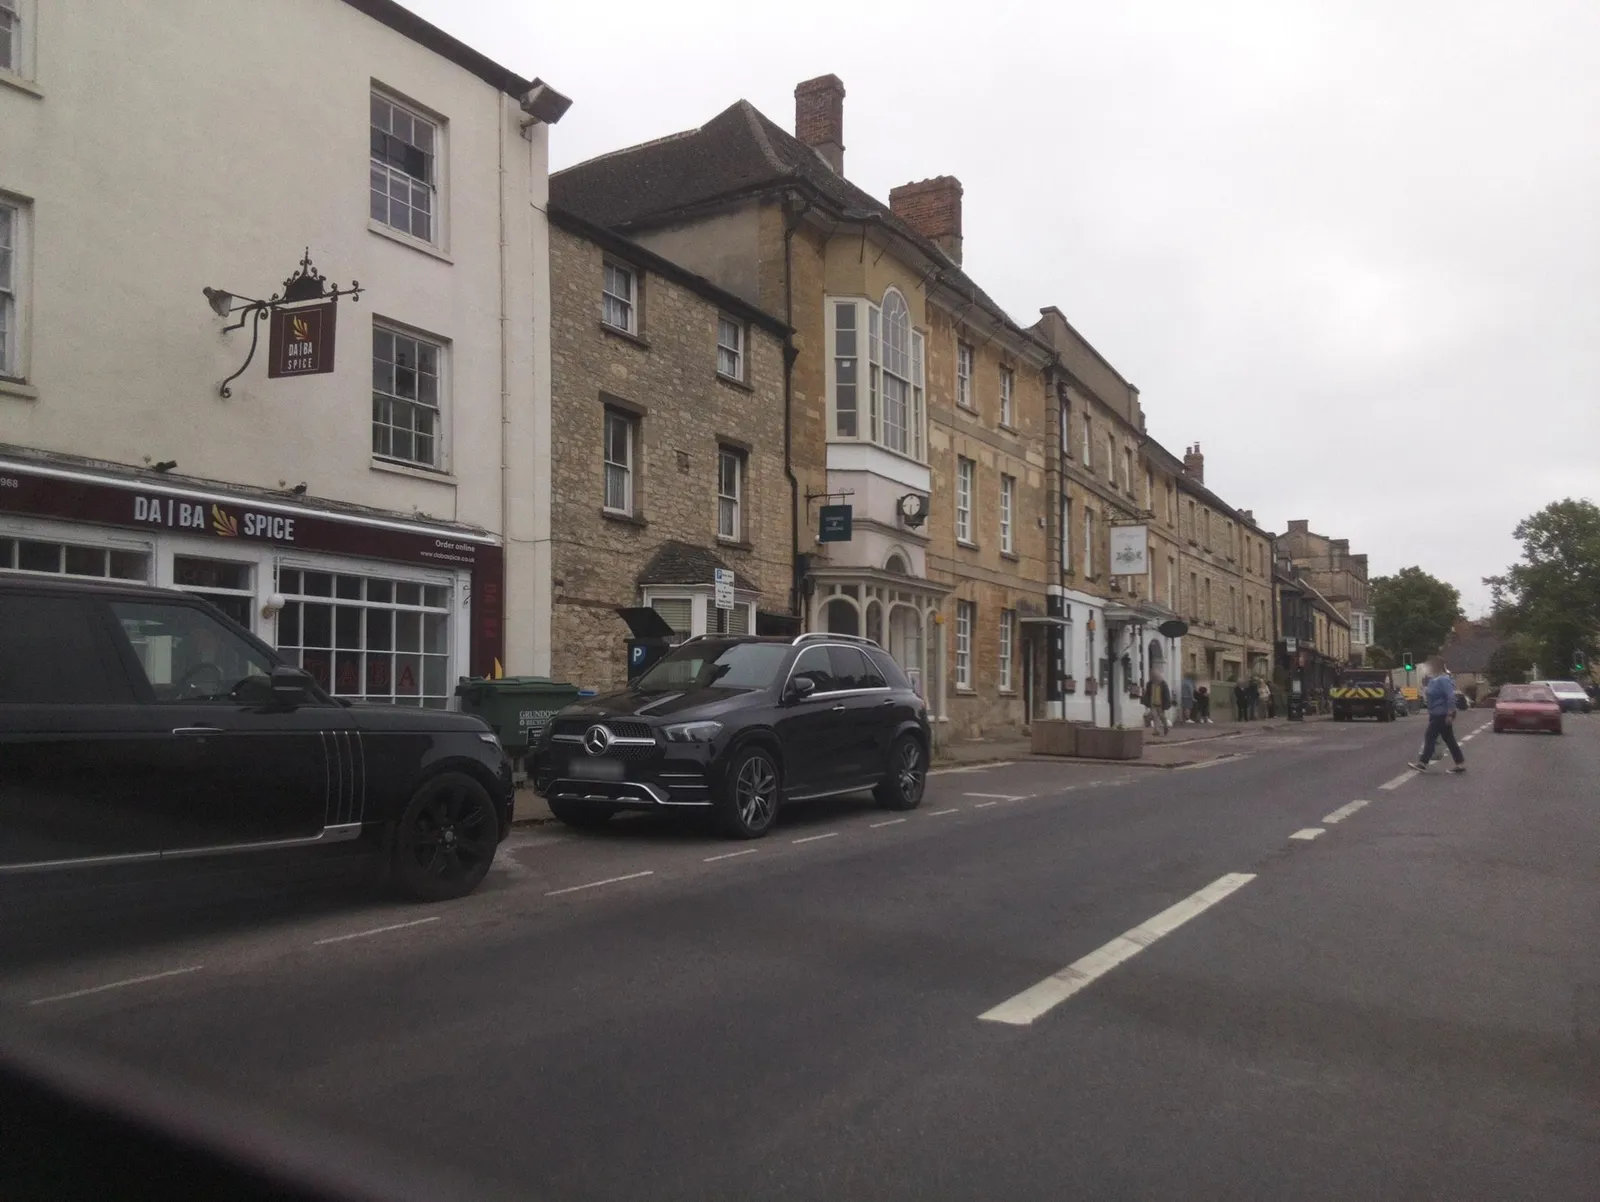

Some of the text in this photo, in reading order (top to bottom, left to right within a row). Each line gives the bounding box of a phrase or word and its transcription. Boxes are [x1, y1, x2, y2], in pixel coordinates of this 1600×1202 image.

[287, 358, 313, 370] SPICE
[0, 477, 19, 489] 968
[243, 512, 295, 541] SPICE
[435, 539, 476, 553] Order online
[633, 647, 643, 662] P
